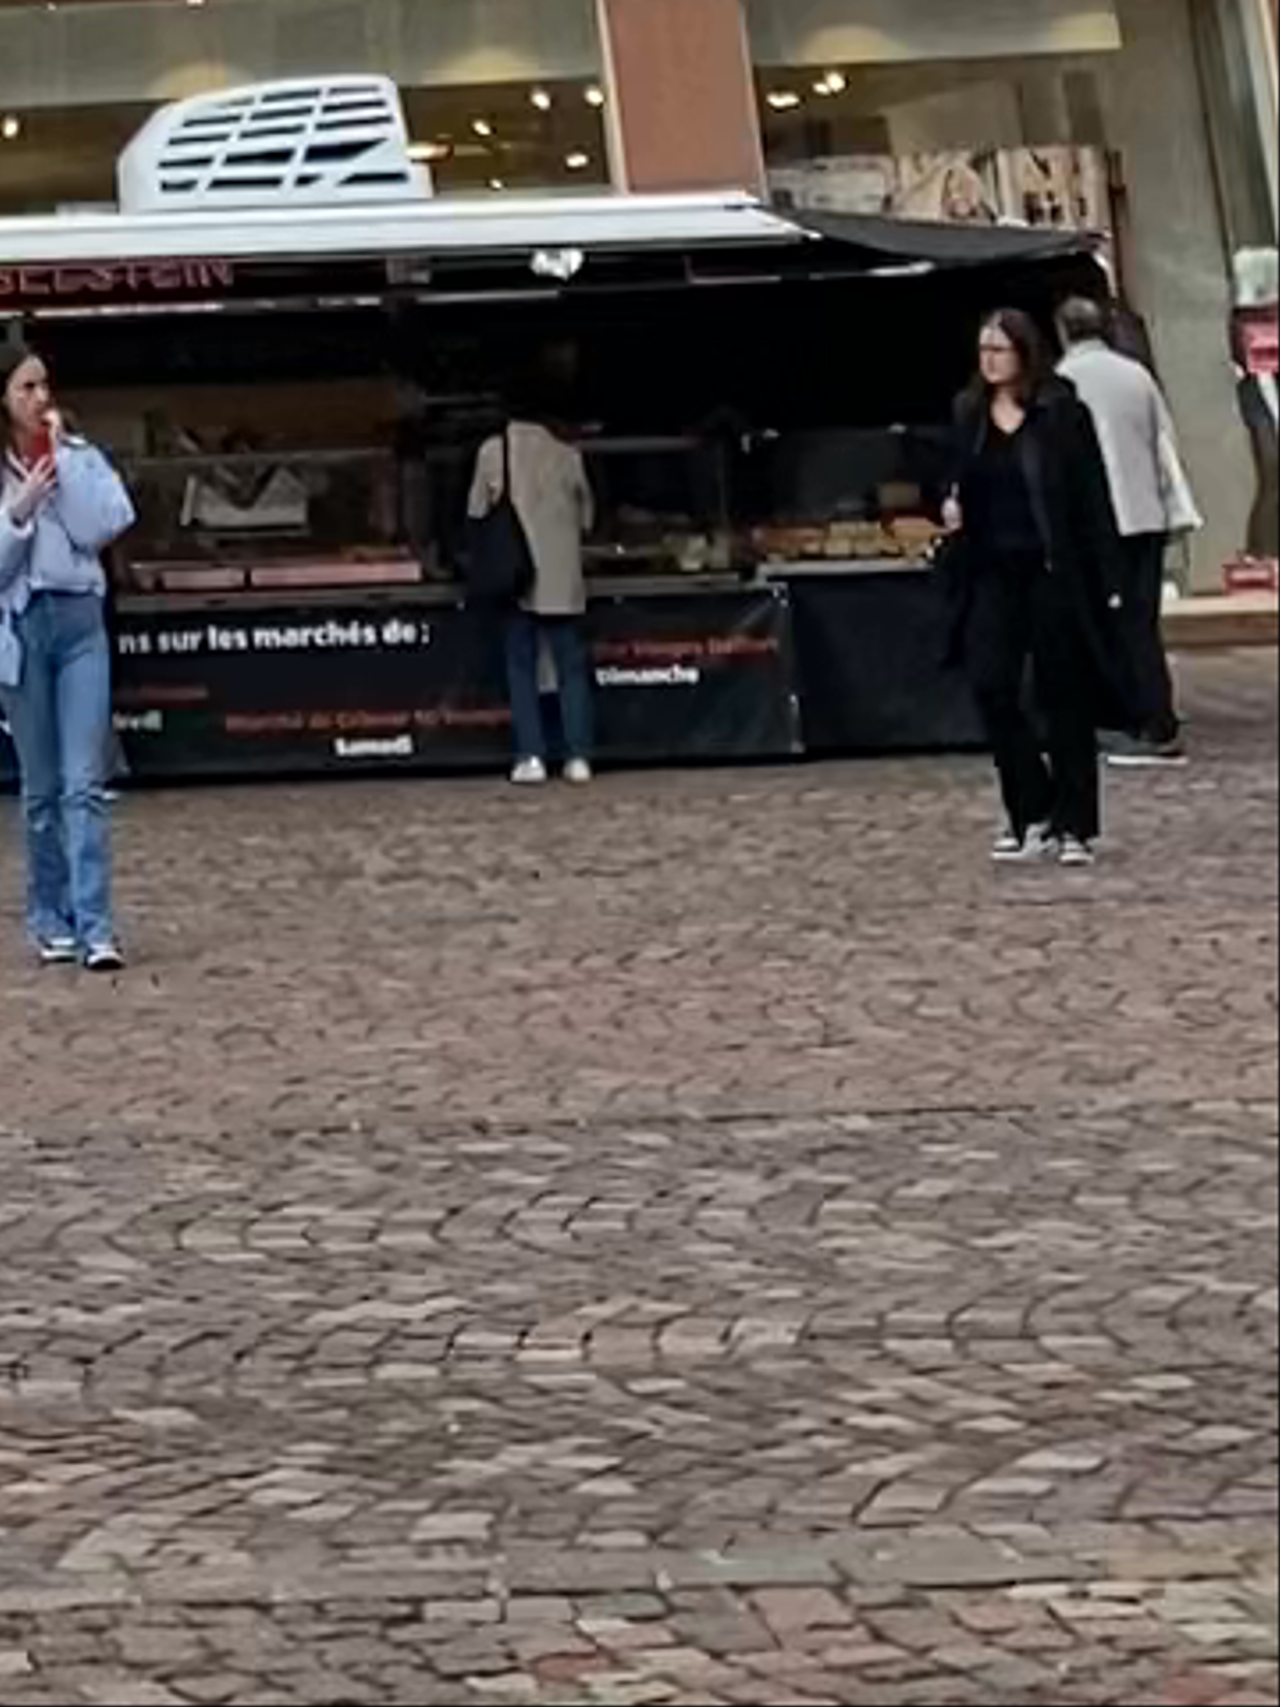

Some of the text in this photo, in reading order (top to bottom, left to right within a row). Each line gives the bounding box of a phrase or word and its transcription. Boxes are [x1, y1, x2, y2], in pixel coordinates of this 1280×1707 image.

[157, 631, 203, 655] sur
[207, 624, 248, 651] les
[253, 620, 376, 650] marchés
